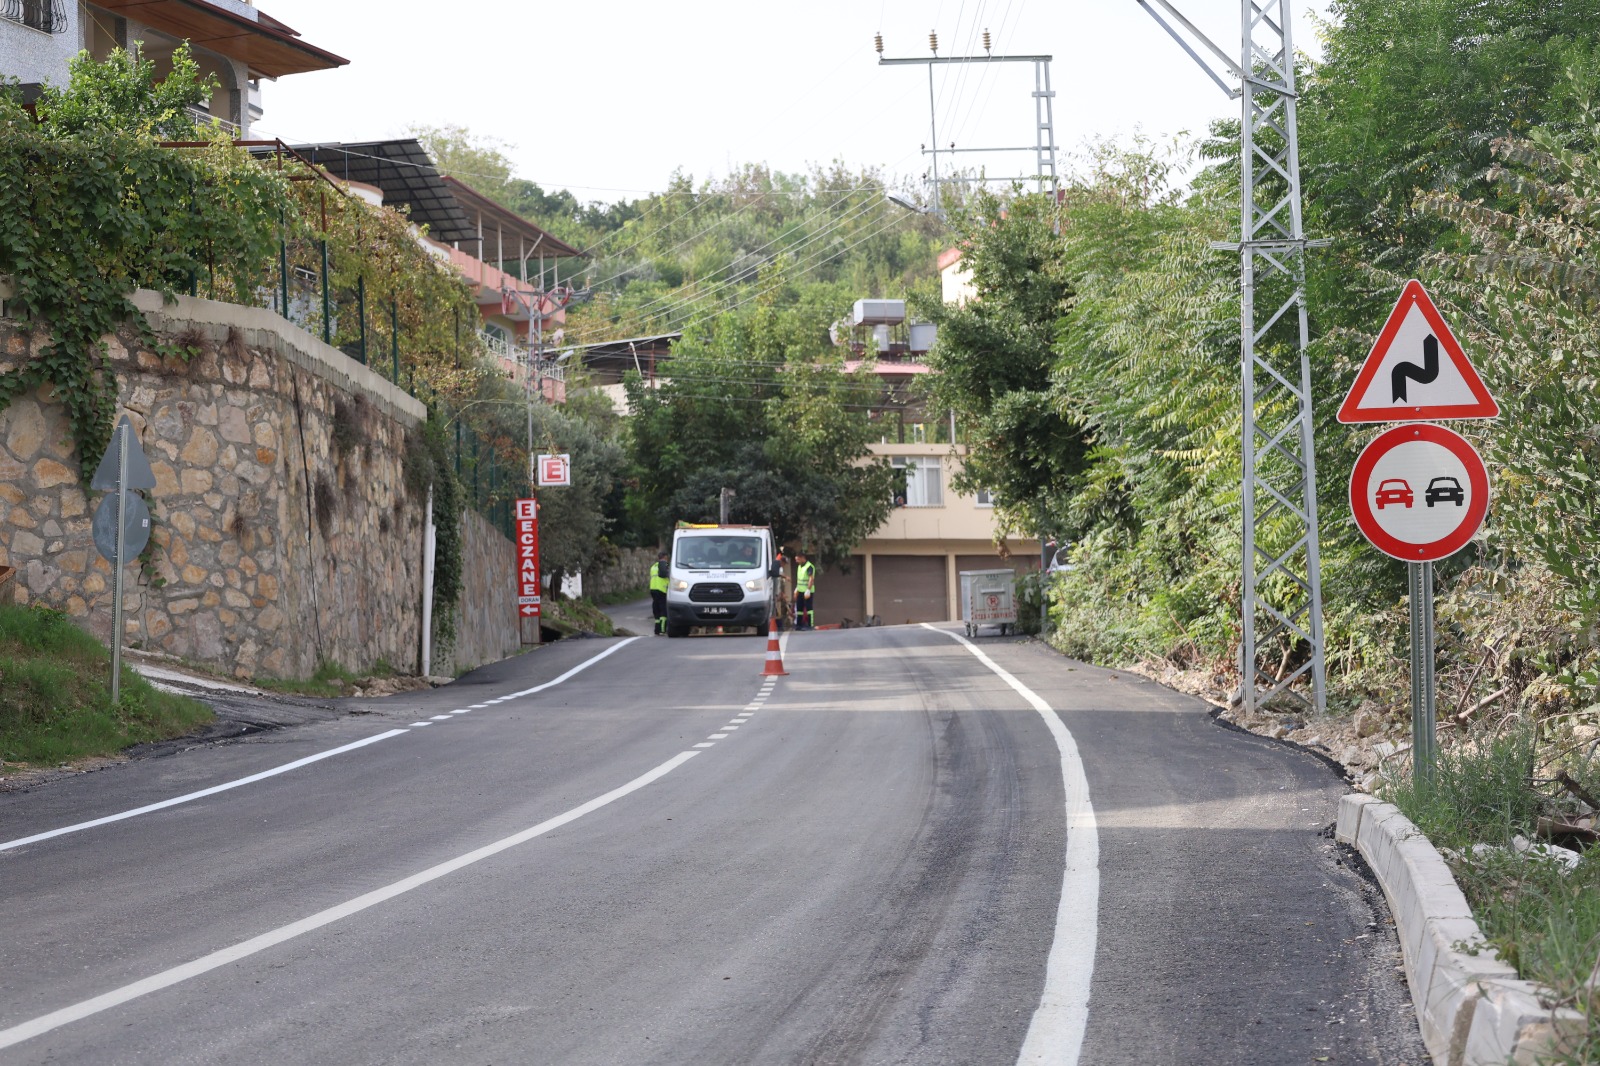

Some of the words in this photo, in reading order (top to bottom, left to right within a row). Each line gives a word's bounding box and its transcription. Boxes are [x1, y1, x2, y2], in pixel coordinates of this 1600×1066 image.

[547, 462, 561, 479] E
[521, 503, 531, 516] E
[521, 521, 535, 595] ECZANE
